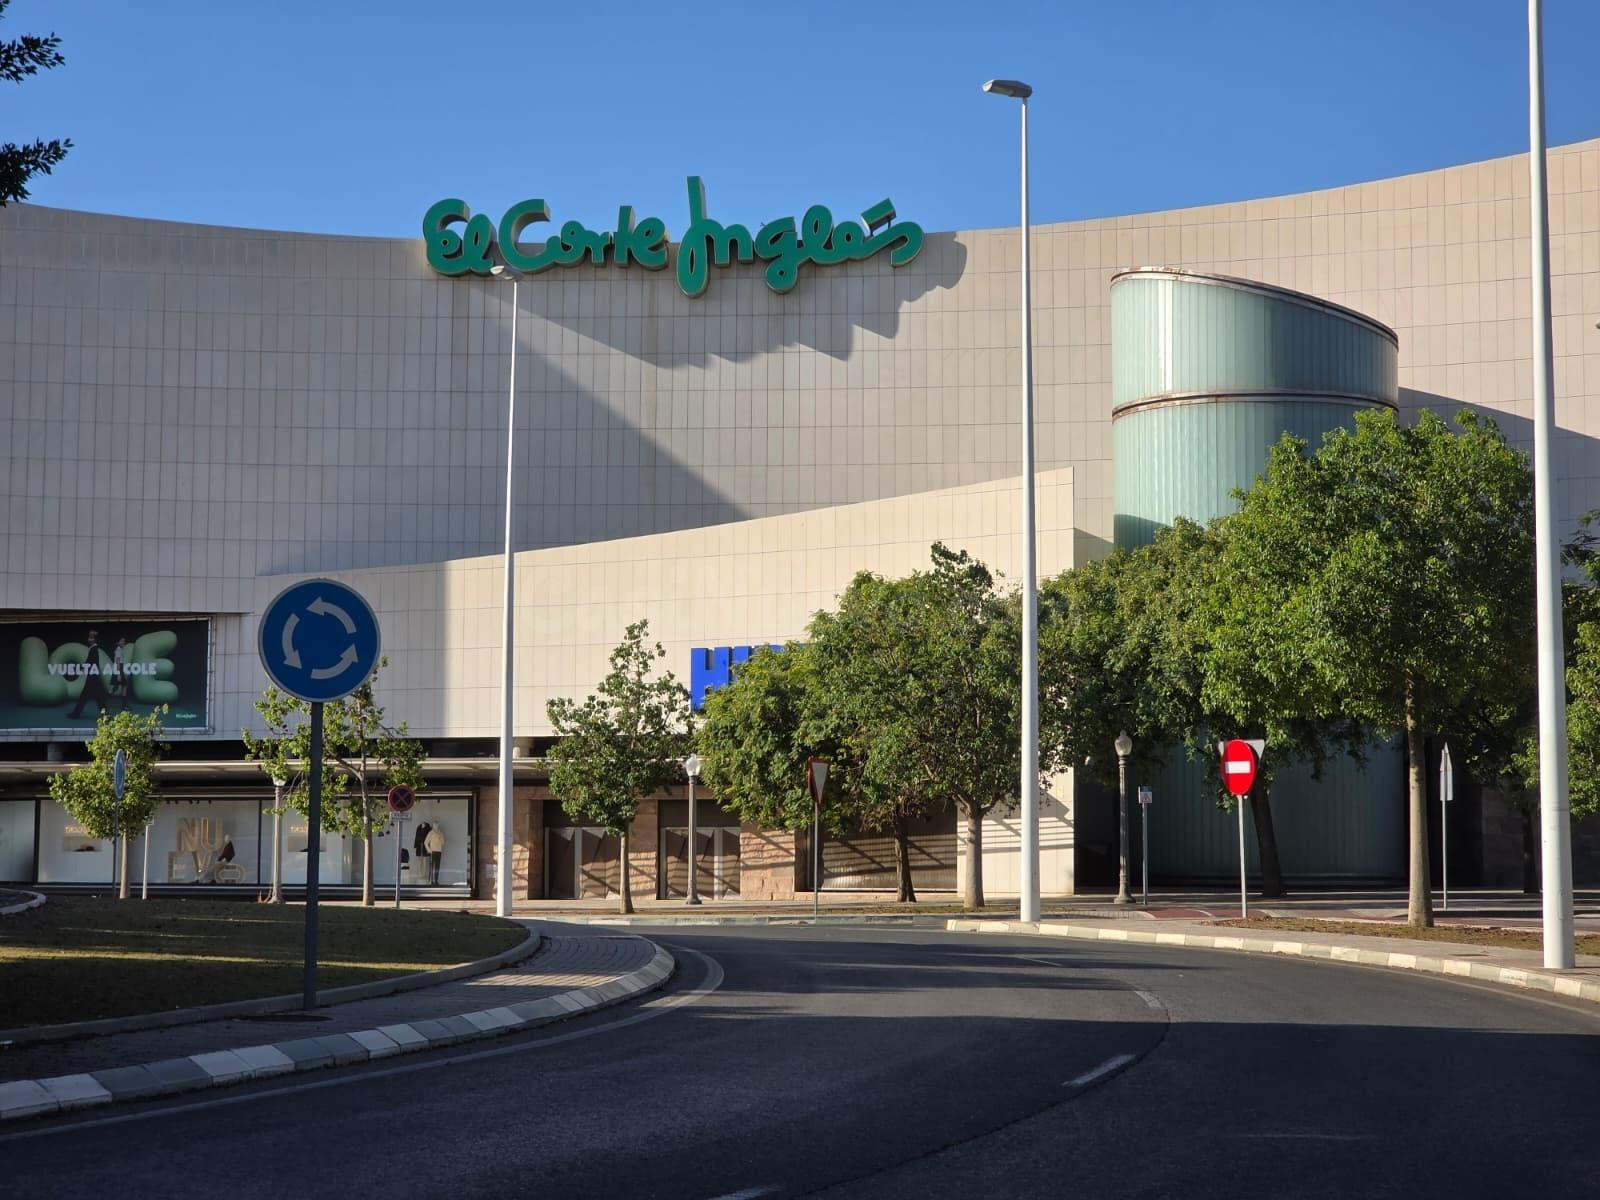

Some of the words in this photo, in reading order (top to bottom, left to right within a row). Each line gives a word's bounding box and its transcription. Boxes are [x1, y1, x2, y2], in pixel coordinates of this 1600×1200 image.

[423, 198, 497, 277] El
[498, 198, 669, 273] Corte
[677, 175, 924, 298] Inglés
[47, 663, 99, 676] VUELTA
[102, 663, 121, 676] AL
[122, 662, 157, 676] COLE
